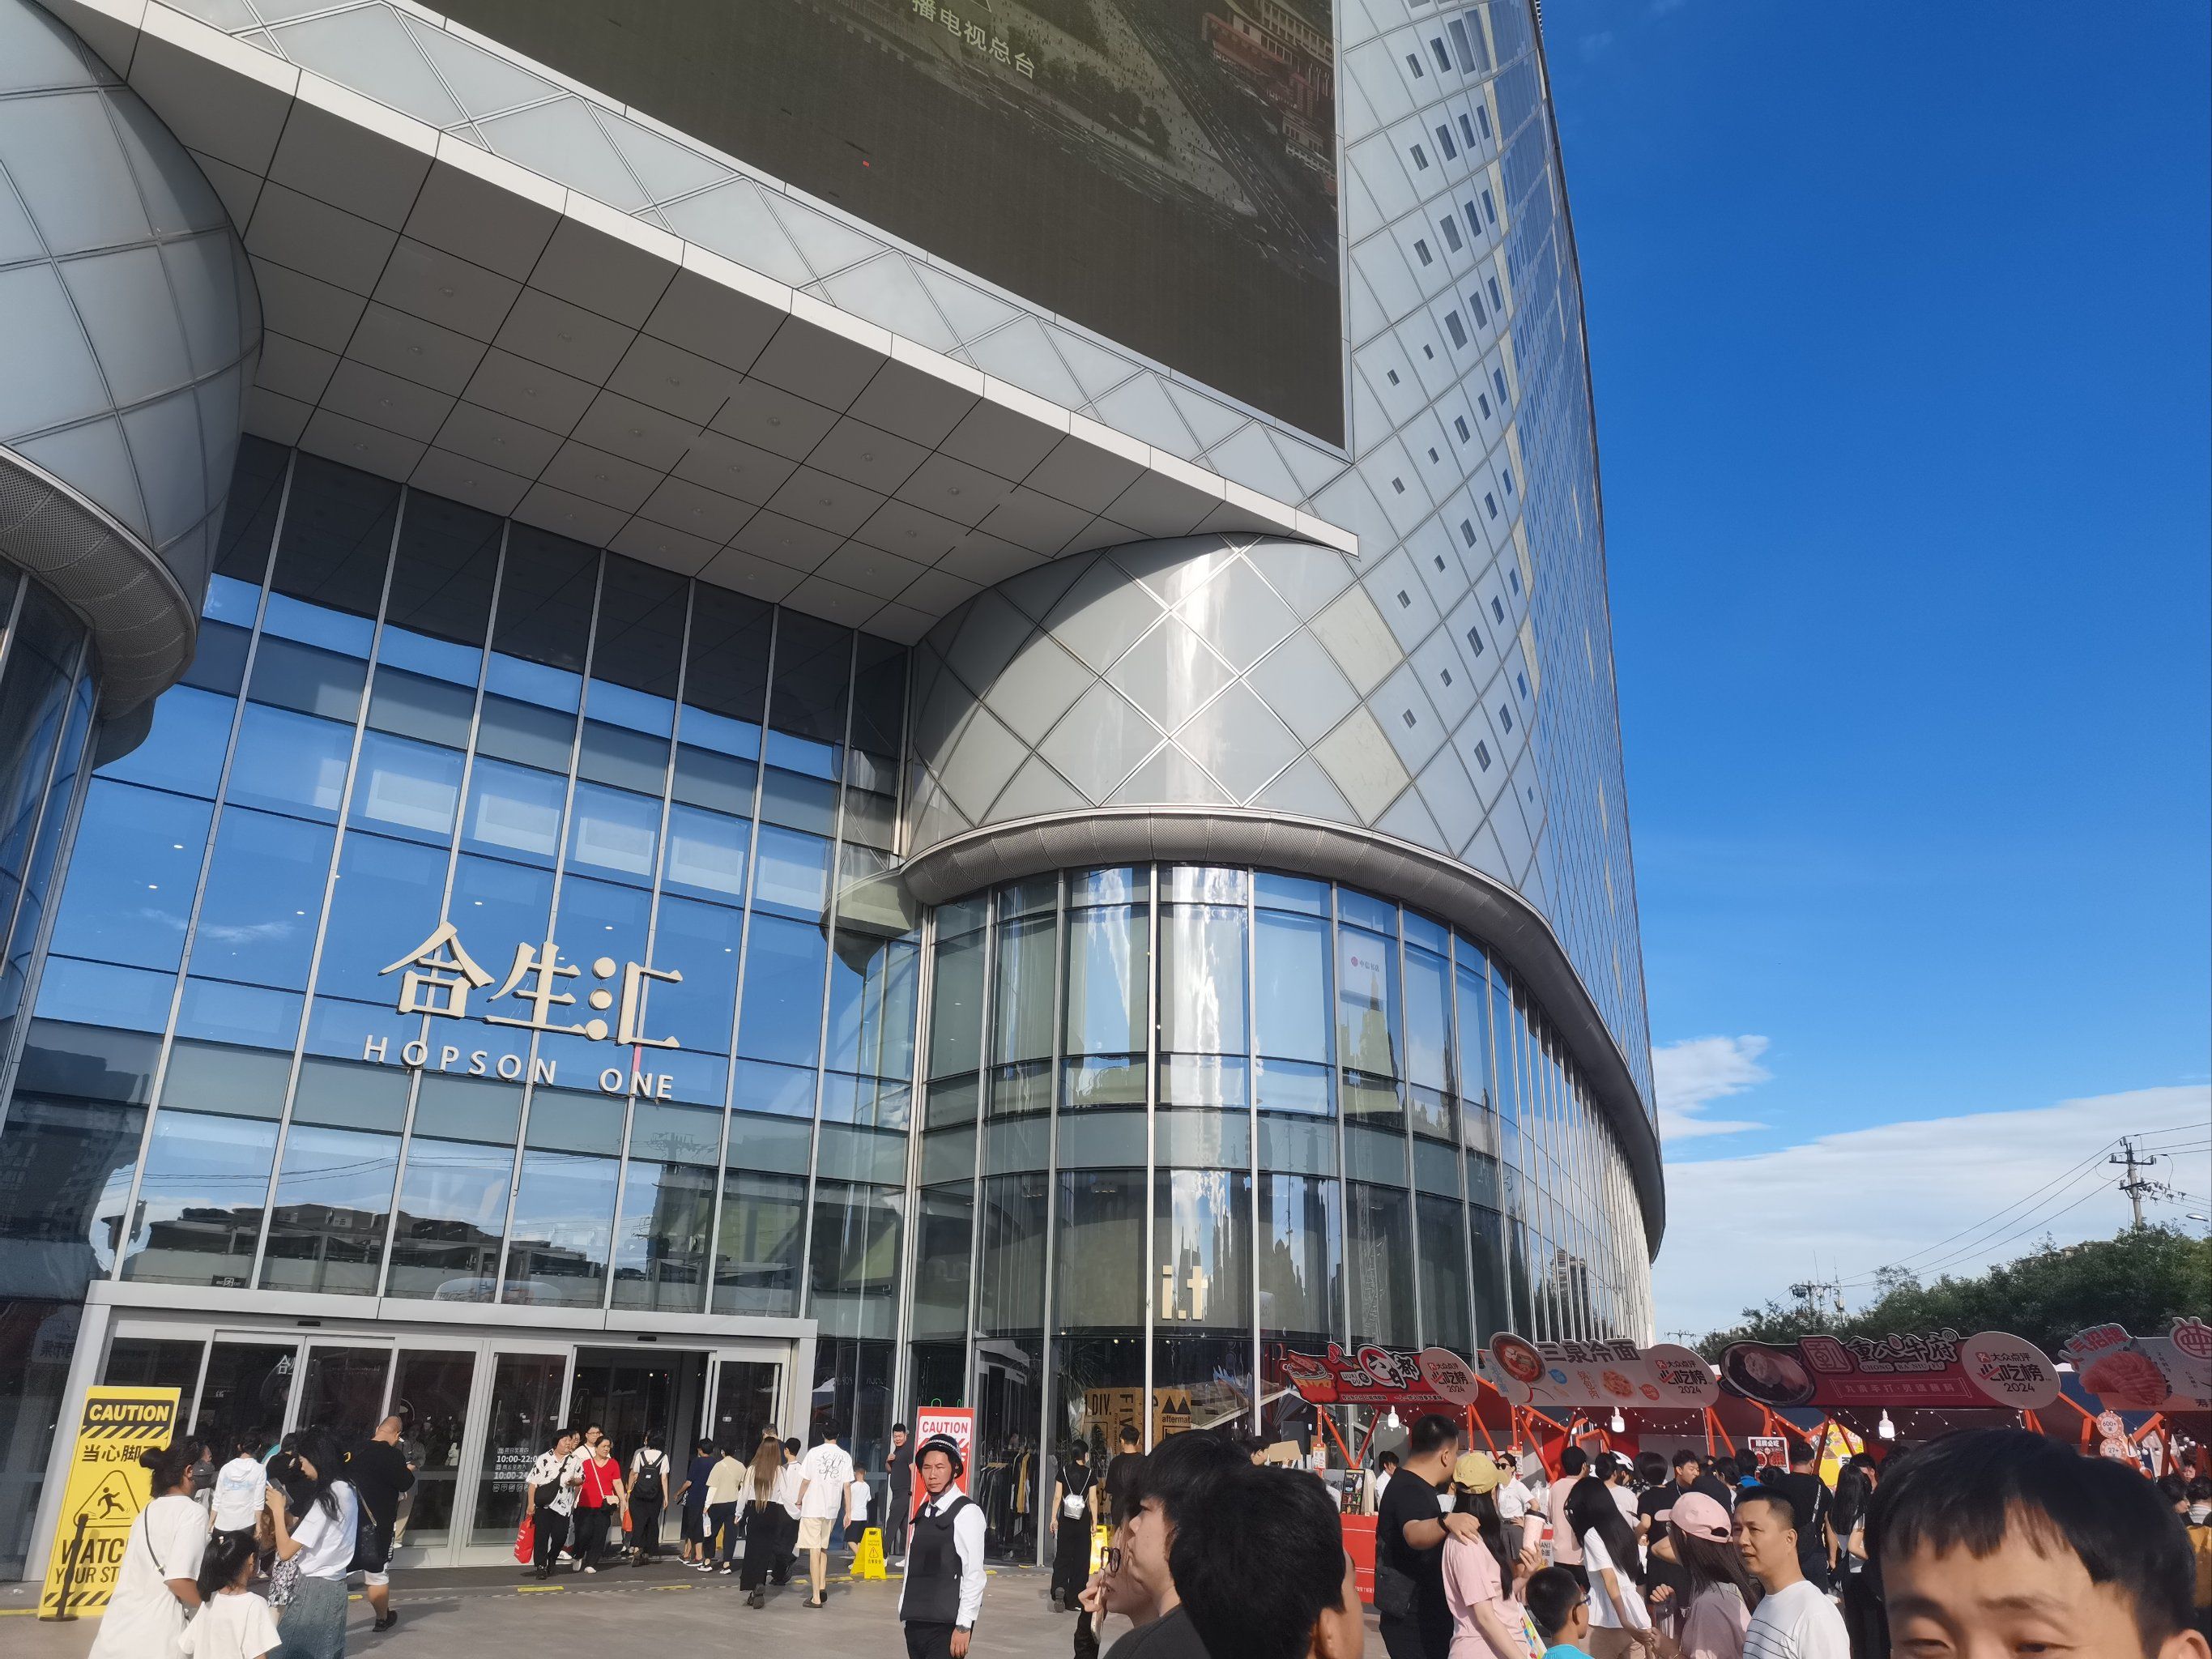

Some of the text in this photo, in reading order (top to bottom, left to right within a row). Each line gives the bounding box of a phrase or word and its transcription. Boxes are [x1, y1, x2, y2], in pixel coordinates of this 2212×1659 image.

[377, 921, 683, 1049] 合生汇
[363, 1034, 674, 1099] HOPSON ONE
[1538, 1341, 1641, 1363] 三泉冷面
[1991, 1352, 2031, 1361] 大众点评
[1431, 1371, 1469, 1384] 必吃榜
[1658, 1370, 1707, 1385] 必吃榜
[1977, 1364, 2044, 1381] 必吃榜
[2004, 1382, 2035, 1392] 2024
[89, 1404, 170, 1422] CAUTION
[1119, 1394, 1133, 1427] FIV
[922, 1421, 969, 1433] CAUTION
[1161, 1415, 1191, 1424] aftermat
[496, 1455, 538, 1463] 10:00-22:0
[493, 1471, 529, 1480] 10:00-24
[61, 1537, 125, 1565] WATC
[55, 1566, 120, 1584] YUR ST
